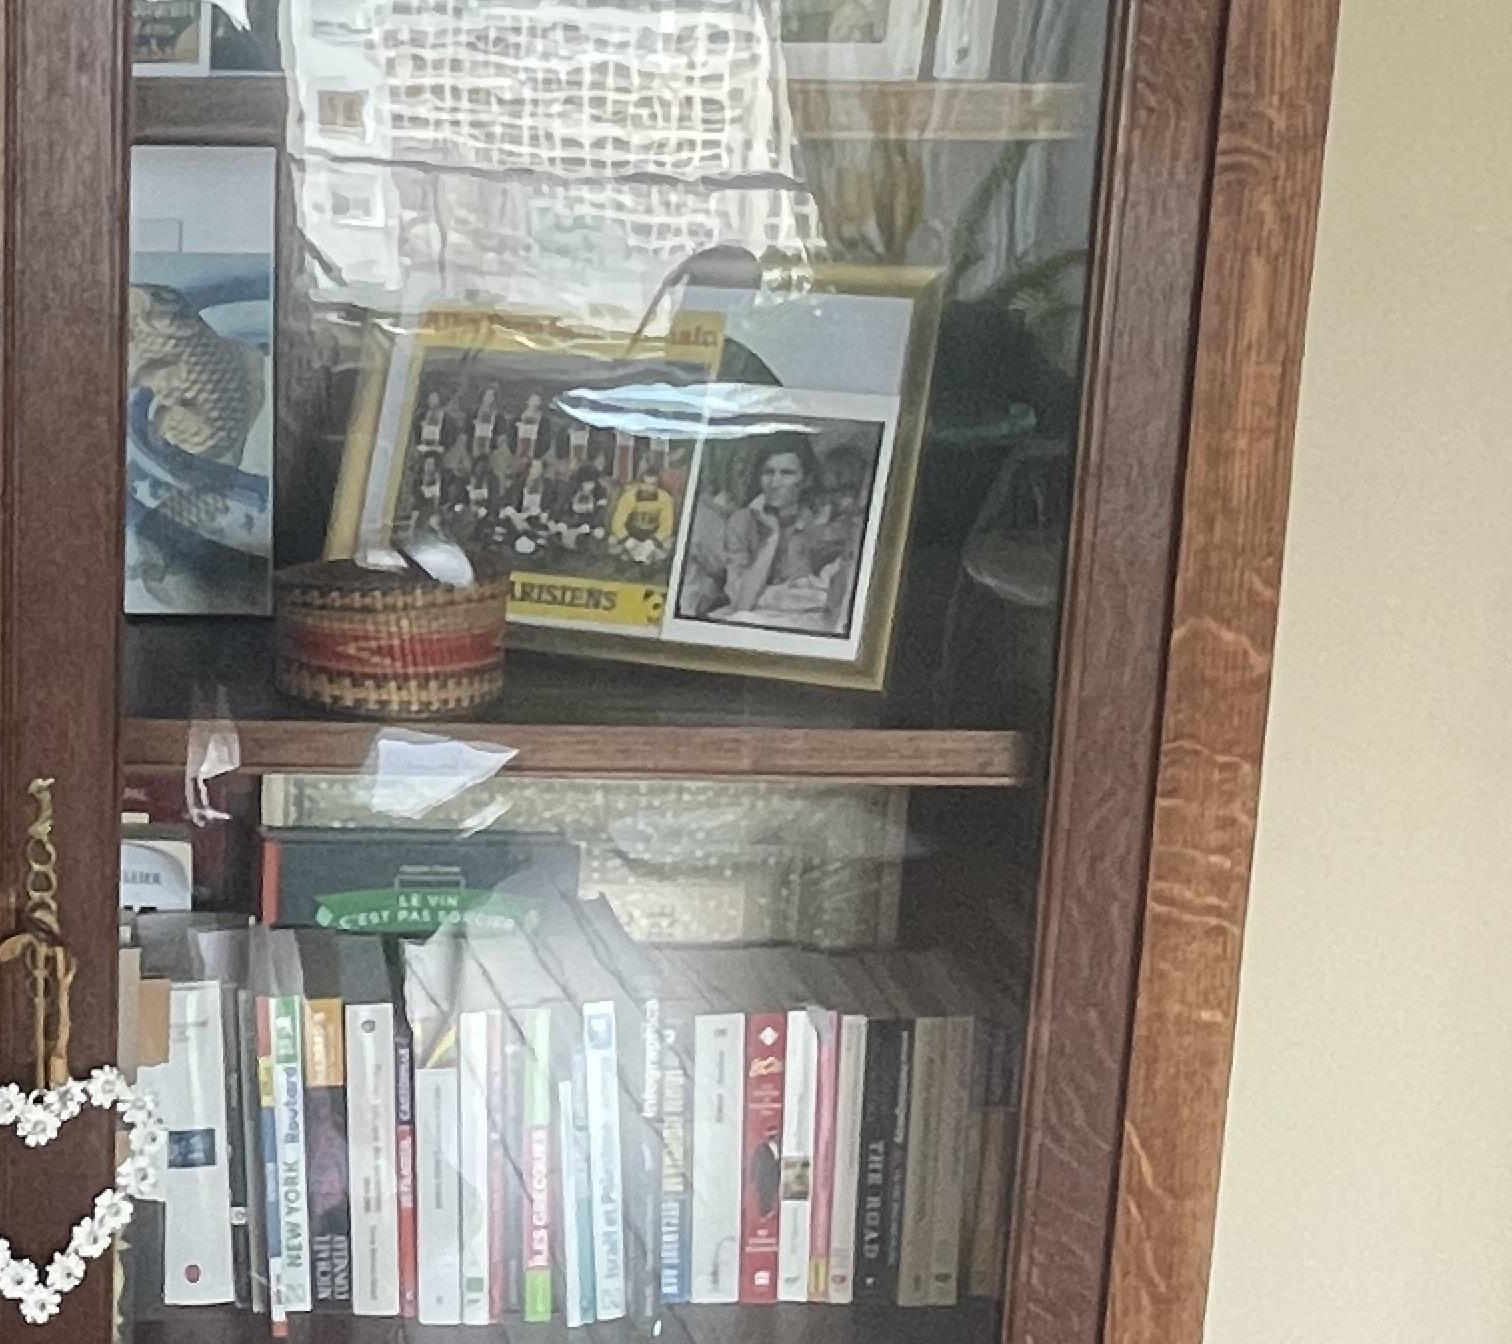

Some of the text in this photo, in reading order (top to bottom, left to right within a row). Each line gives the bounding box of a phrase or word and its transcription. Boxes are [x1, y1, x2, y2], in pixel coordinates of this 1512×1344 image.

[427, 894, 459, 907] VIN
[282, 1158, 304, 1219] YORK
[284, 1220, 304, 1269] NEW
